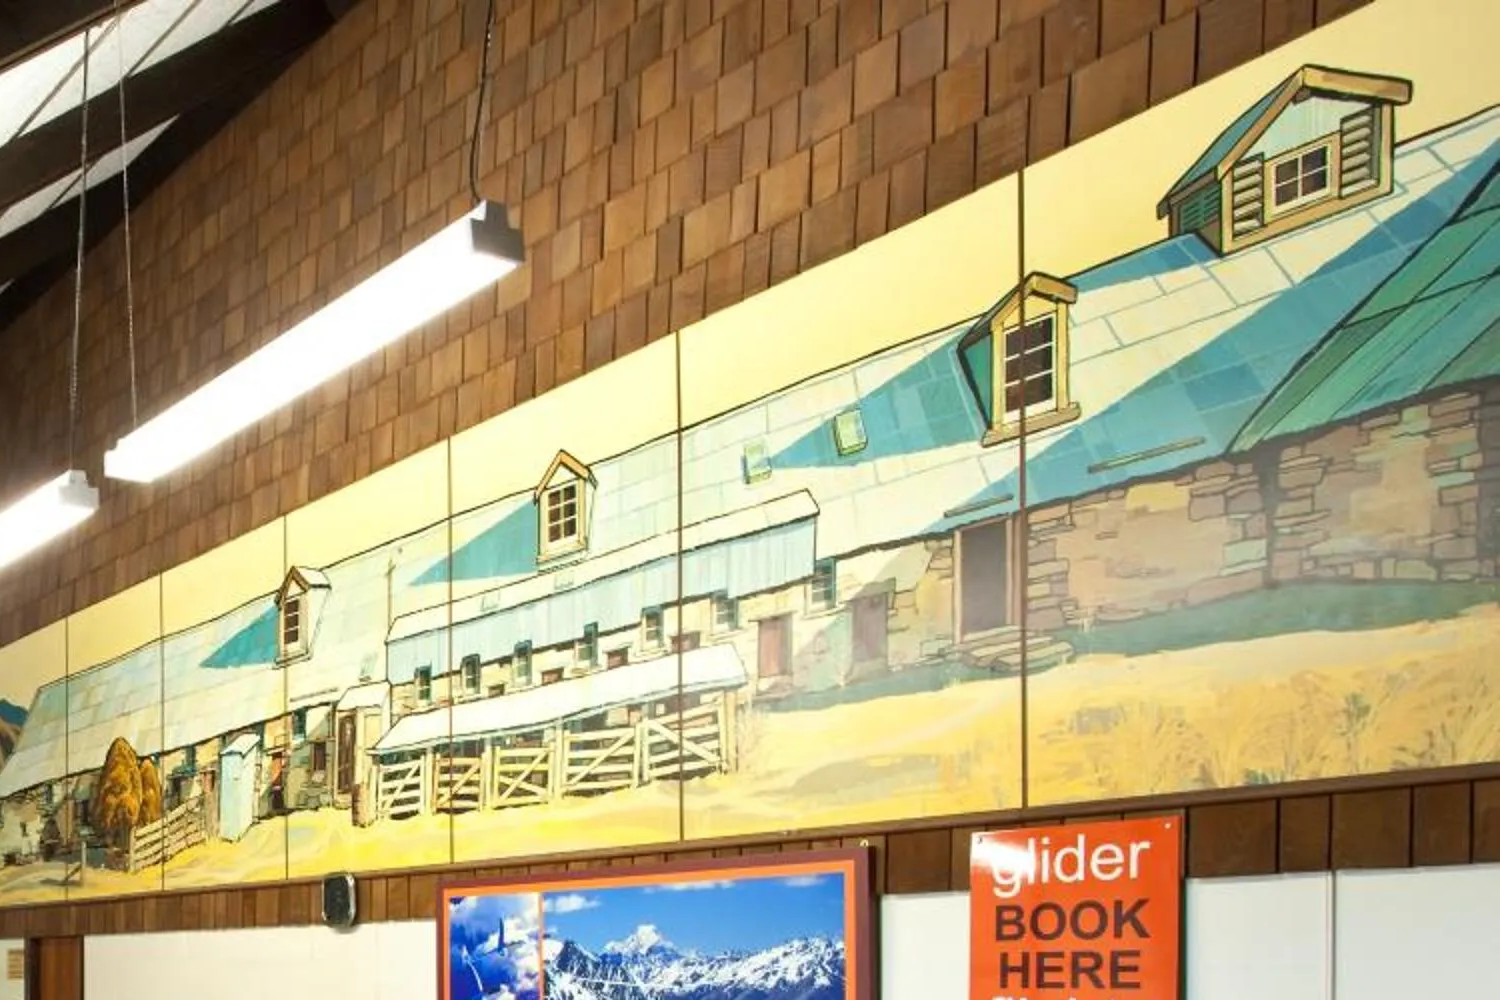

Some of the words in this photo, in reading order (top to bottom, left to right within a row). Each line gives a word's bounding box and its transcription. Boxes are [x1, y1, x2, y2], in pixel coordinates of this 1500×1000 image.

[991, 833, 1151, 898] glider
[994, 898, 1151, 942] BOOK
[999, 950, 1141, 990] HERE
